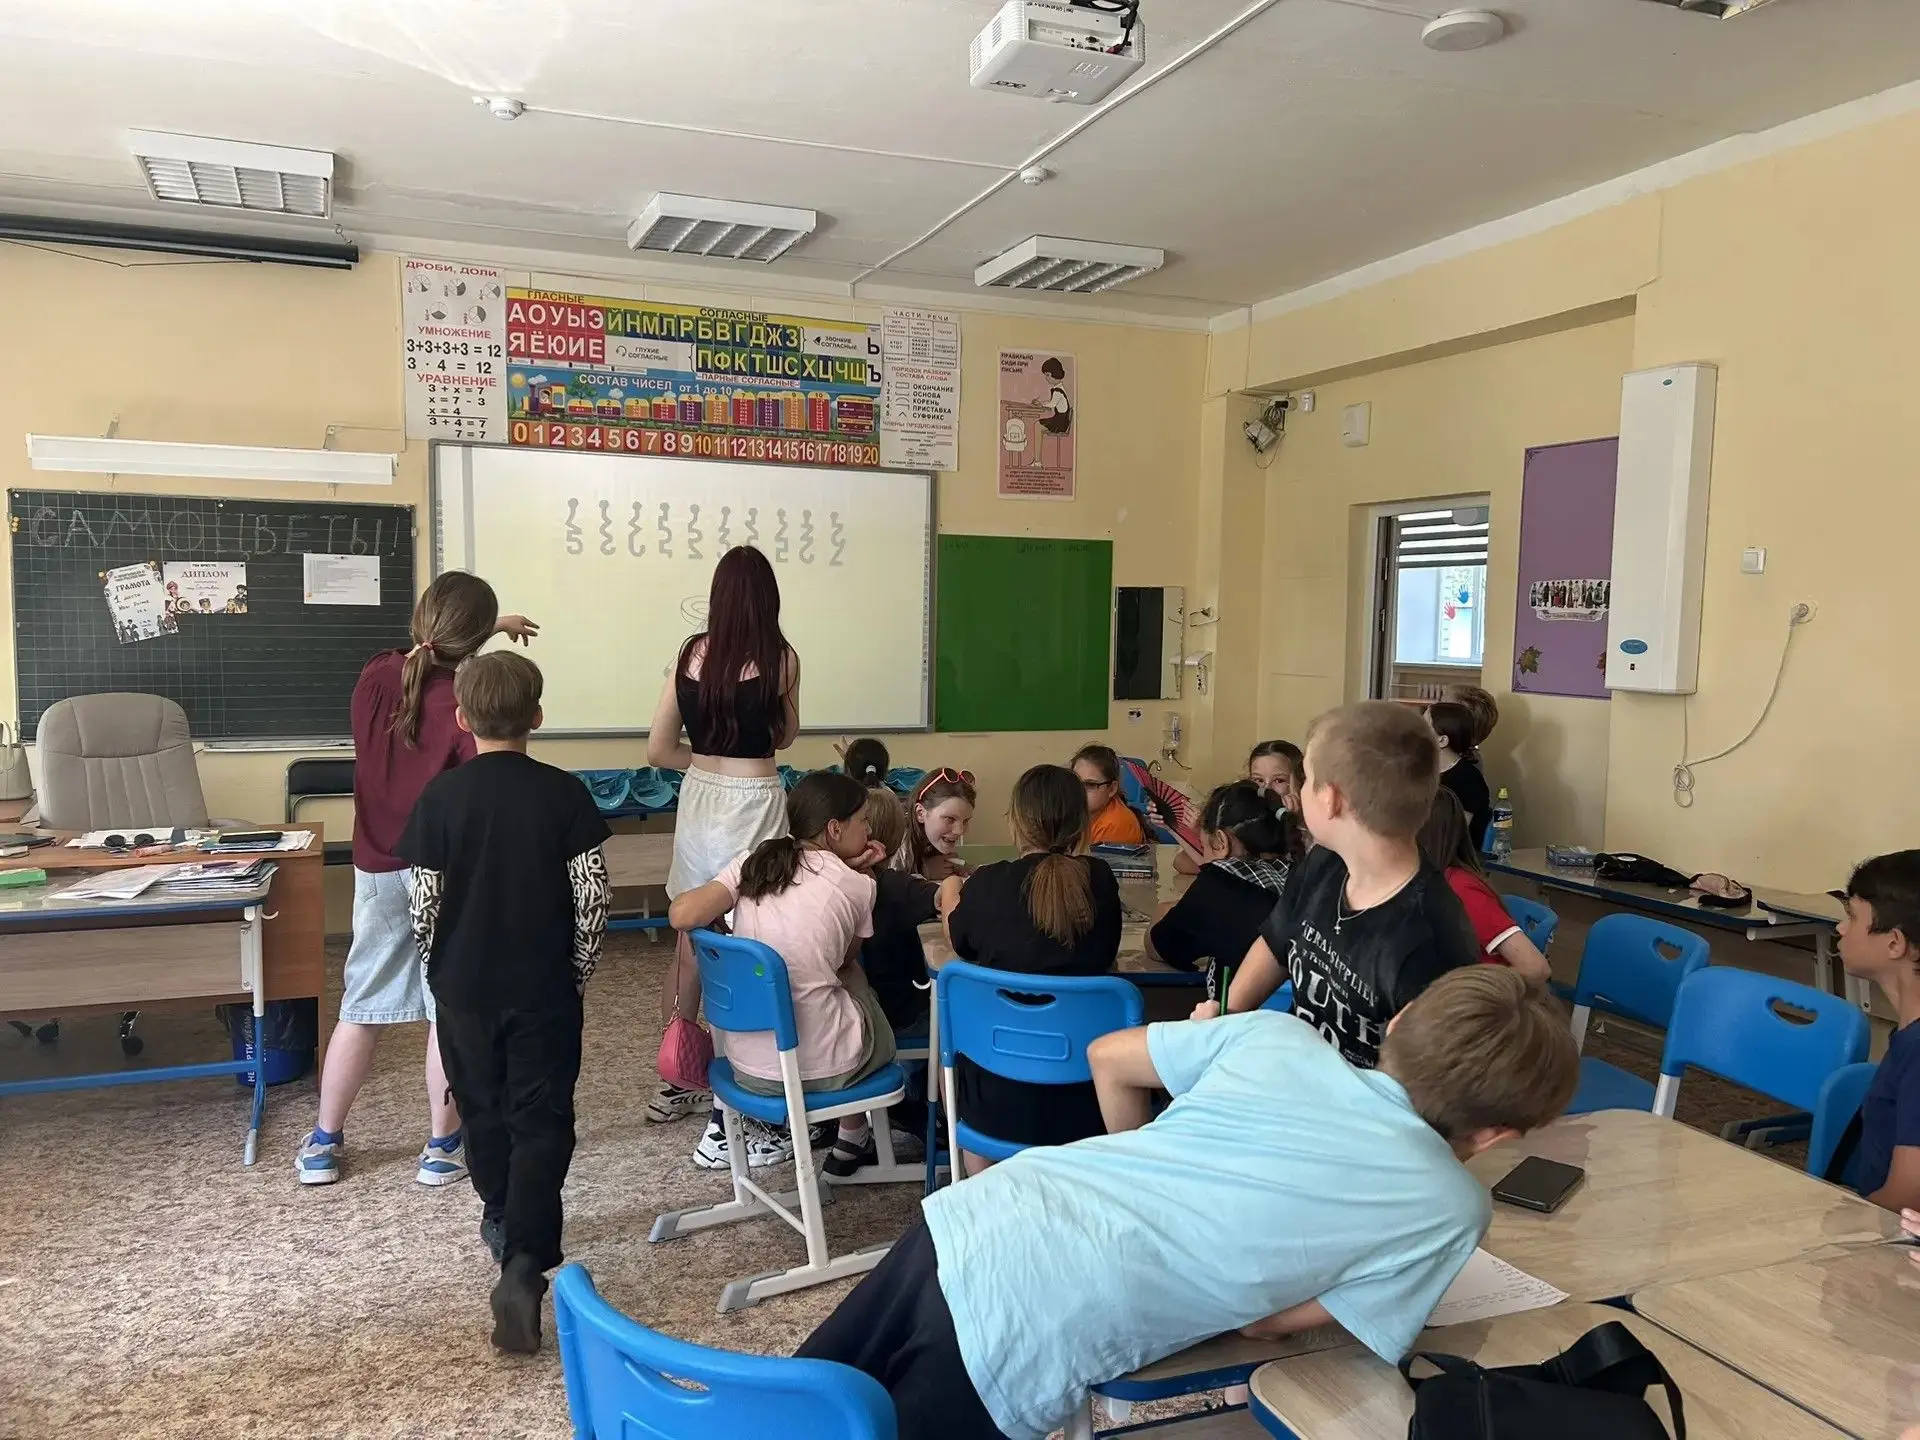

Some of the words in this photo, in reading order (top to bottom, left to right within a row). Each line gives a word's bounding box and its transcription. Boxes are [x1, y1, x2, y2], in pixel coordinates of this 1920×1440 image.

[460, 267, 497, 277] ДОЛИ
[528, 290, 584, 304] ГЛАСНЫЕ
[700, 308, 768, 322] СОГЛАСНЫЕ
[418, 326, 491, 339] УМНОЖЕНИЕ
[487, 345, 501, 357] 12
[820, 342, 857, 350] СОГЛАСНЫЕ
[628, 352, 668, 361] СОГЛАСНЫЕ
[408, 357, 416, 369] 3
[438, 360, 446, 371] 4
[476, 362, 491, 374] 12
[417, 373, 496, 387] УРАВНЕНИЕ
[579, 374, 628, 387] СОСТАВ
[632, 378, 672, 391] ЧИСЕЛ
[695, 384, 700, 393] 1
[703, 387, 718, 395] до
[721, 387, 732, 395] 10
[702, 374, 739, 383] ПАРНЫЕ
[742, 376, 795, 387] СОГЛАСНЫЕ
[477, 387, 484, 395] 7
[912, 384, 954, 393] ОКОНЧАНИЕ
[453, 396, 460, 404] 7
[912, 391, 941, 399] ОСНОВА
[912, 398, 940, 406] КОРЕНЬ
[912, 405, 952, 414] ПРИСТАВКА
[912, 412, 945, 421] СУФФИКС
[479, 420, 486, 428] 7
[455, 429, 462, 438] 7
[479, 431, 486, 439] 7
[513, 423, 528, 443] 0
[534, 425, 543, 444] 1
[551, 426, 566, 445] 2
[571, 427, 584, 446] 3
[587, 428, 601, 448] 4
[608, 429, 621, 448] 5
[625, 430, 640, 450] 6
[645, 432, 658, 450] 7
[663, 433, 676, 452] 8
[680, 434, 693, 453] 9
[696, 435, 712, 455] 10
[714, 436, 728, 456] 11
[730, 438, 747, 457] 12
[748, 439, 765, 458] 13
[766, 440, 783, 459] 14
[784, 441, 799, 460] 15
[800, 442, 815, 461] 16
[816, 443, 831, 461] 17
[831, 443, 847, 463] 18
[847, 444, 862, 464] 19
[863, 446, 878, 465] 20
[181, 570, 229, 578] ДИПЛОМ
[115, 580, 151, 592] ГРАМОТА
[247, 1071, 255, 1082] НЕ
